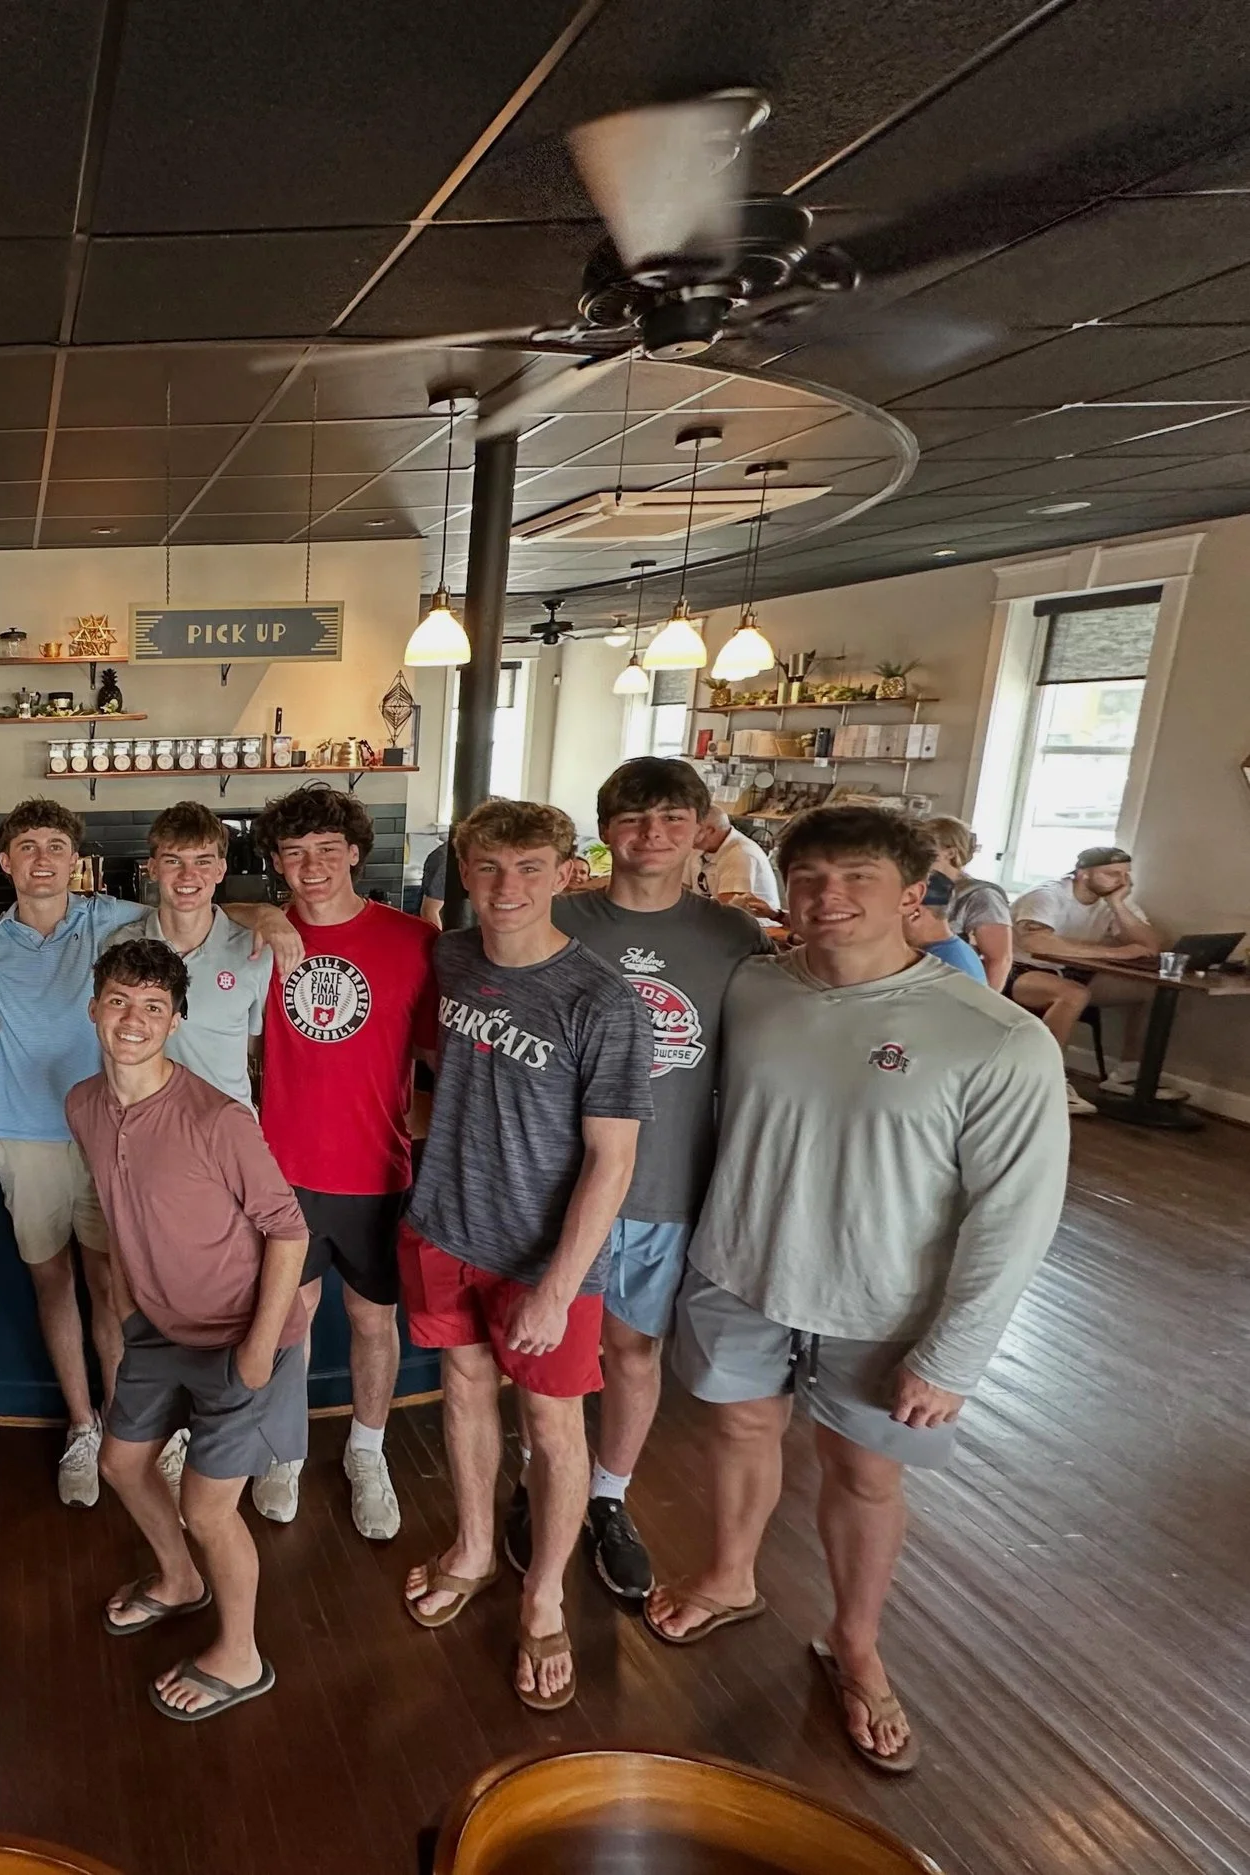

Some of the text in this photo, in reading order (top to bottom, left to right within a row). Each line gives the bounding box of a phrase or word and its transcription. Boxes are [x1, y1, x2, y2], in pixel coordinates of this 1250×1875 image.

[187, 623, 287, 644] PICK UP
[619, 947, 666, 968] Skyline
[311, 971, 342, 984] STATE
[285, 957, 369, 1019] INDIAN HILL BRAVES
[311, 982, 341, 995] FINAL
[311, 994, 339, 1006] FOUR
[293, 1016, 356, 1040] BASEBALL
[654, 1048, 692, 1060] OWCASE
